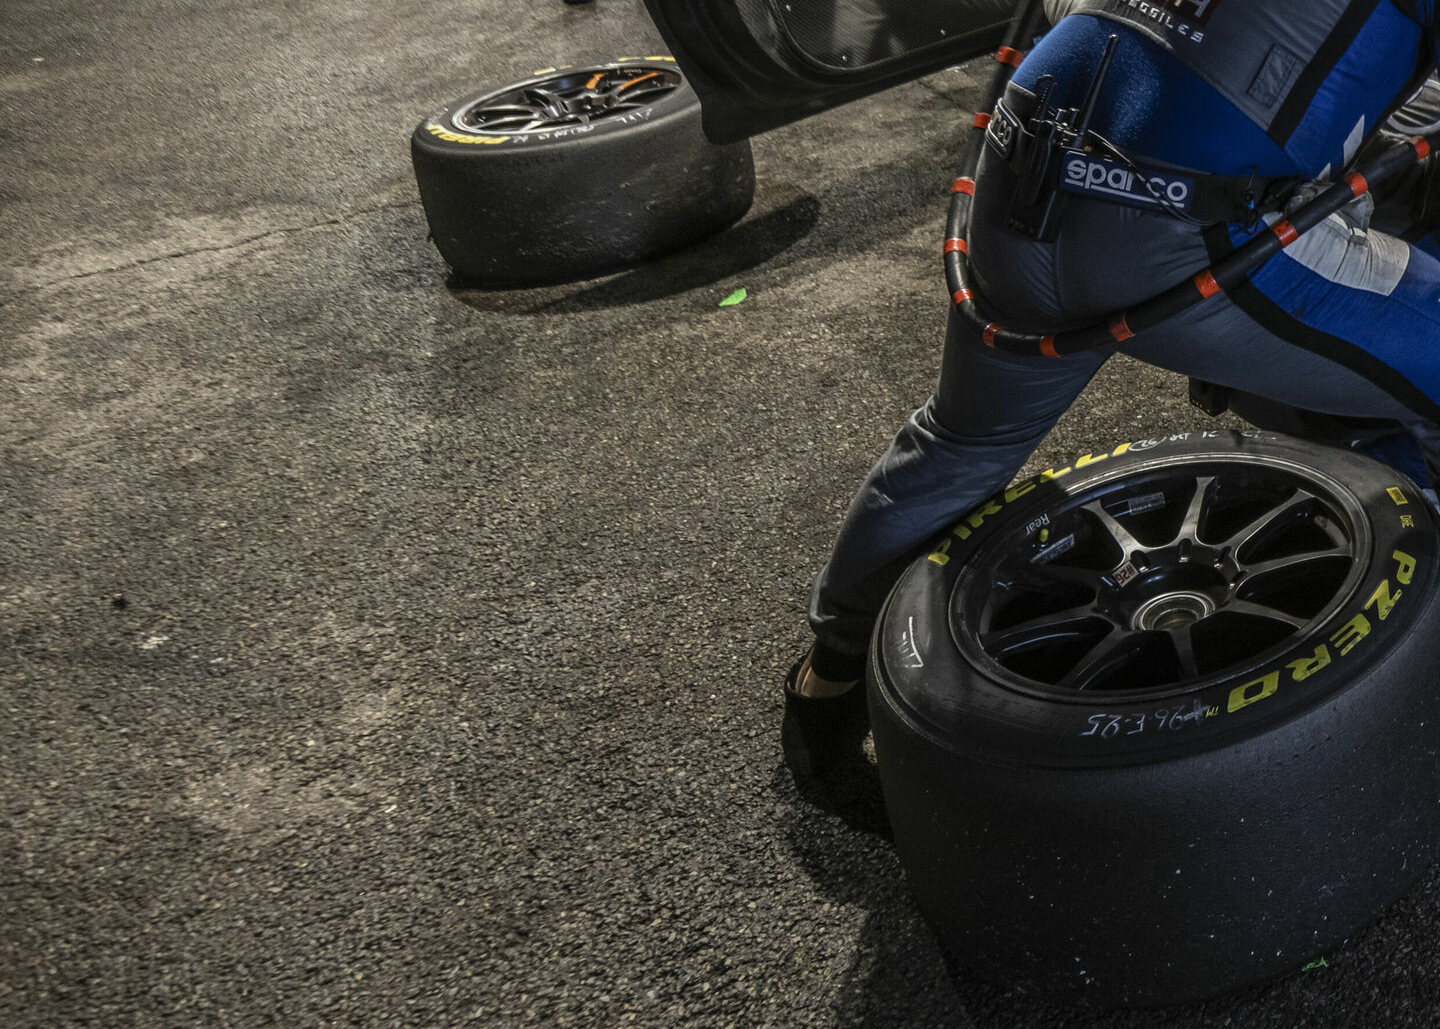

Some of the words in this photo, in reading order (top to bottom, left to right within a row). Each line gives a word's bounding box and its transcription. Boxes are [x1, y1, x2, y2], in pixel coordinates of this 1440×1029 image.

[1066, 160, 1188, 202] sparco
[928, 442, 1132, 566] PIRELLI
[1024, 513, 1050, 537] Rear
[1115, 564, 1136, 587] #26
